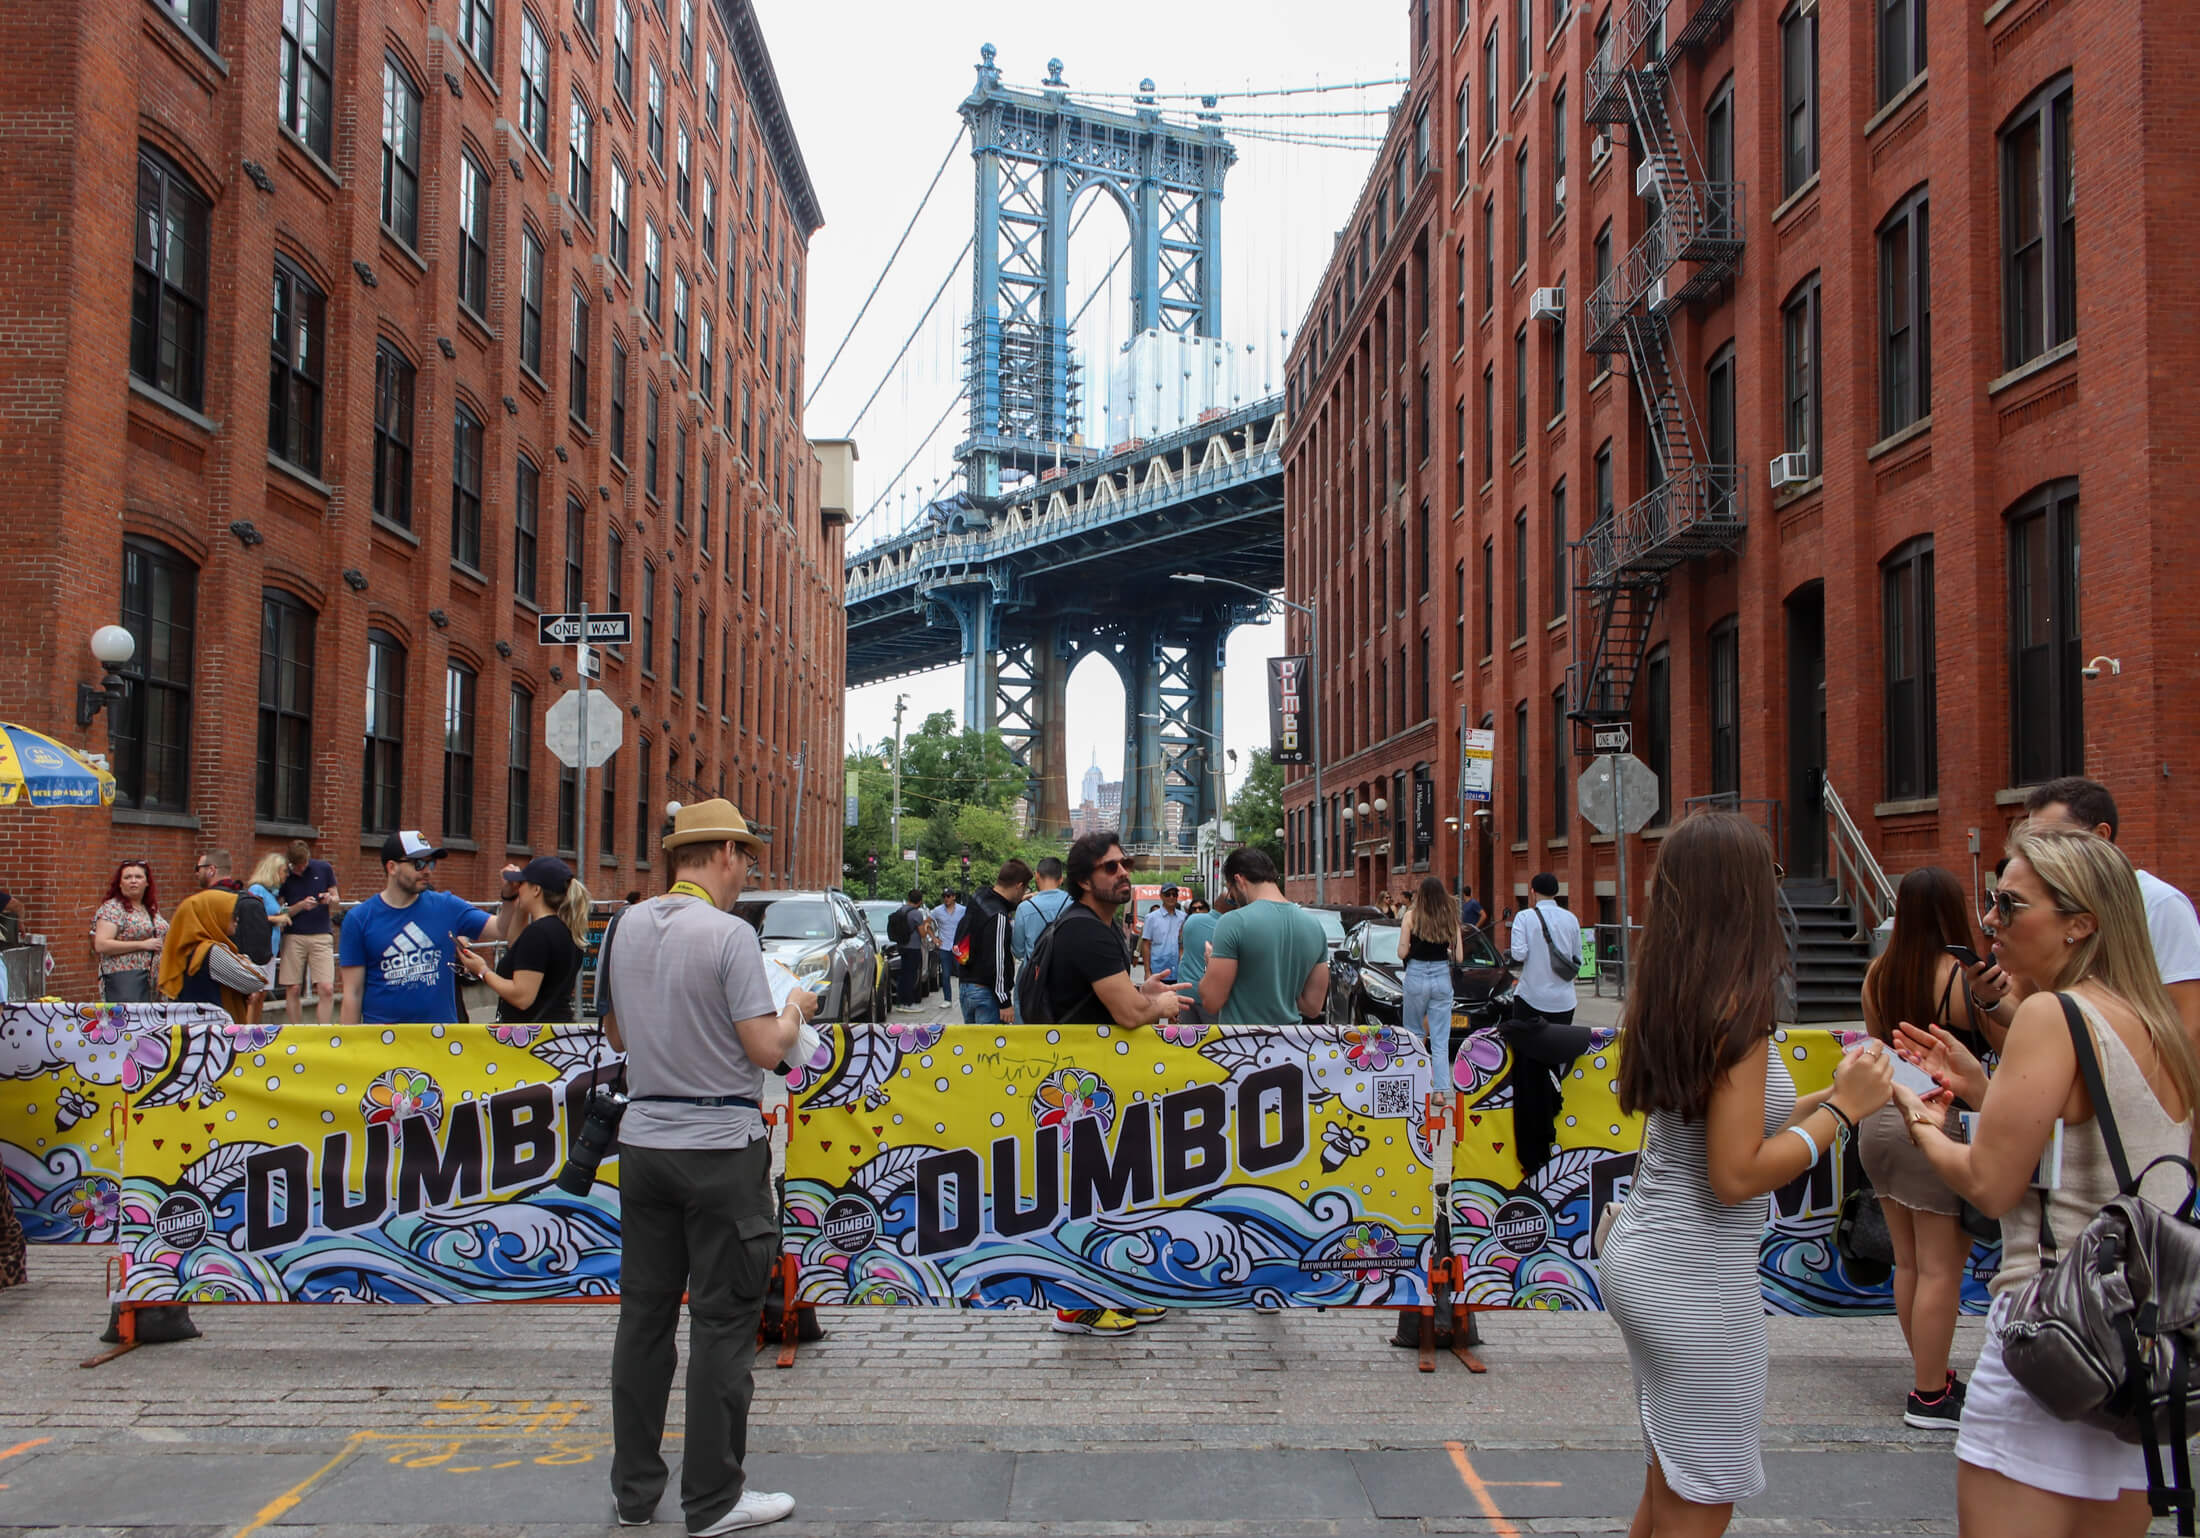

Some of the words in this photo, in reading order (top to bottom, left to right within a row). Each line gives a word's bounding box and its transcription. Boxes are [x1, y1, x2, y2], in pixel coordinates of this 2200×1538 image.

[554, 623, 579, 635] ONE
[591, 622, 618, 634] WAY
[1280, 661, 1300, 750] DUMBO
[1599, 734, 1609, 746] ONE
[1613, 733, 1625, 745] WAY
[380, 948, 442, 971] adidas
[915, 1061, 1305, 1257] DUMBO
[159, 1212, 203, 1234] DUMBO
[826, 1215, 872, 1236] DUMBO
[1497, 1218, 1545, 1237] DUMBO
[1300, 1261, 1331, 1270] ARTWORK
[1332, 1260, 1341, 1268] BY
